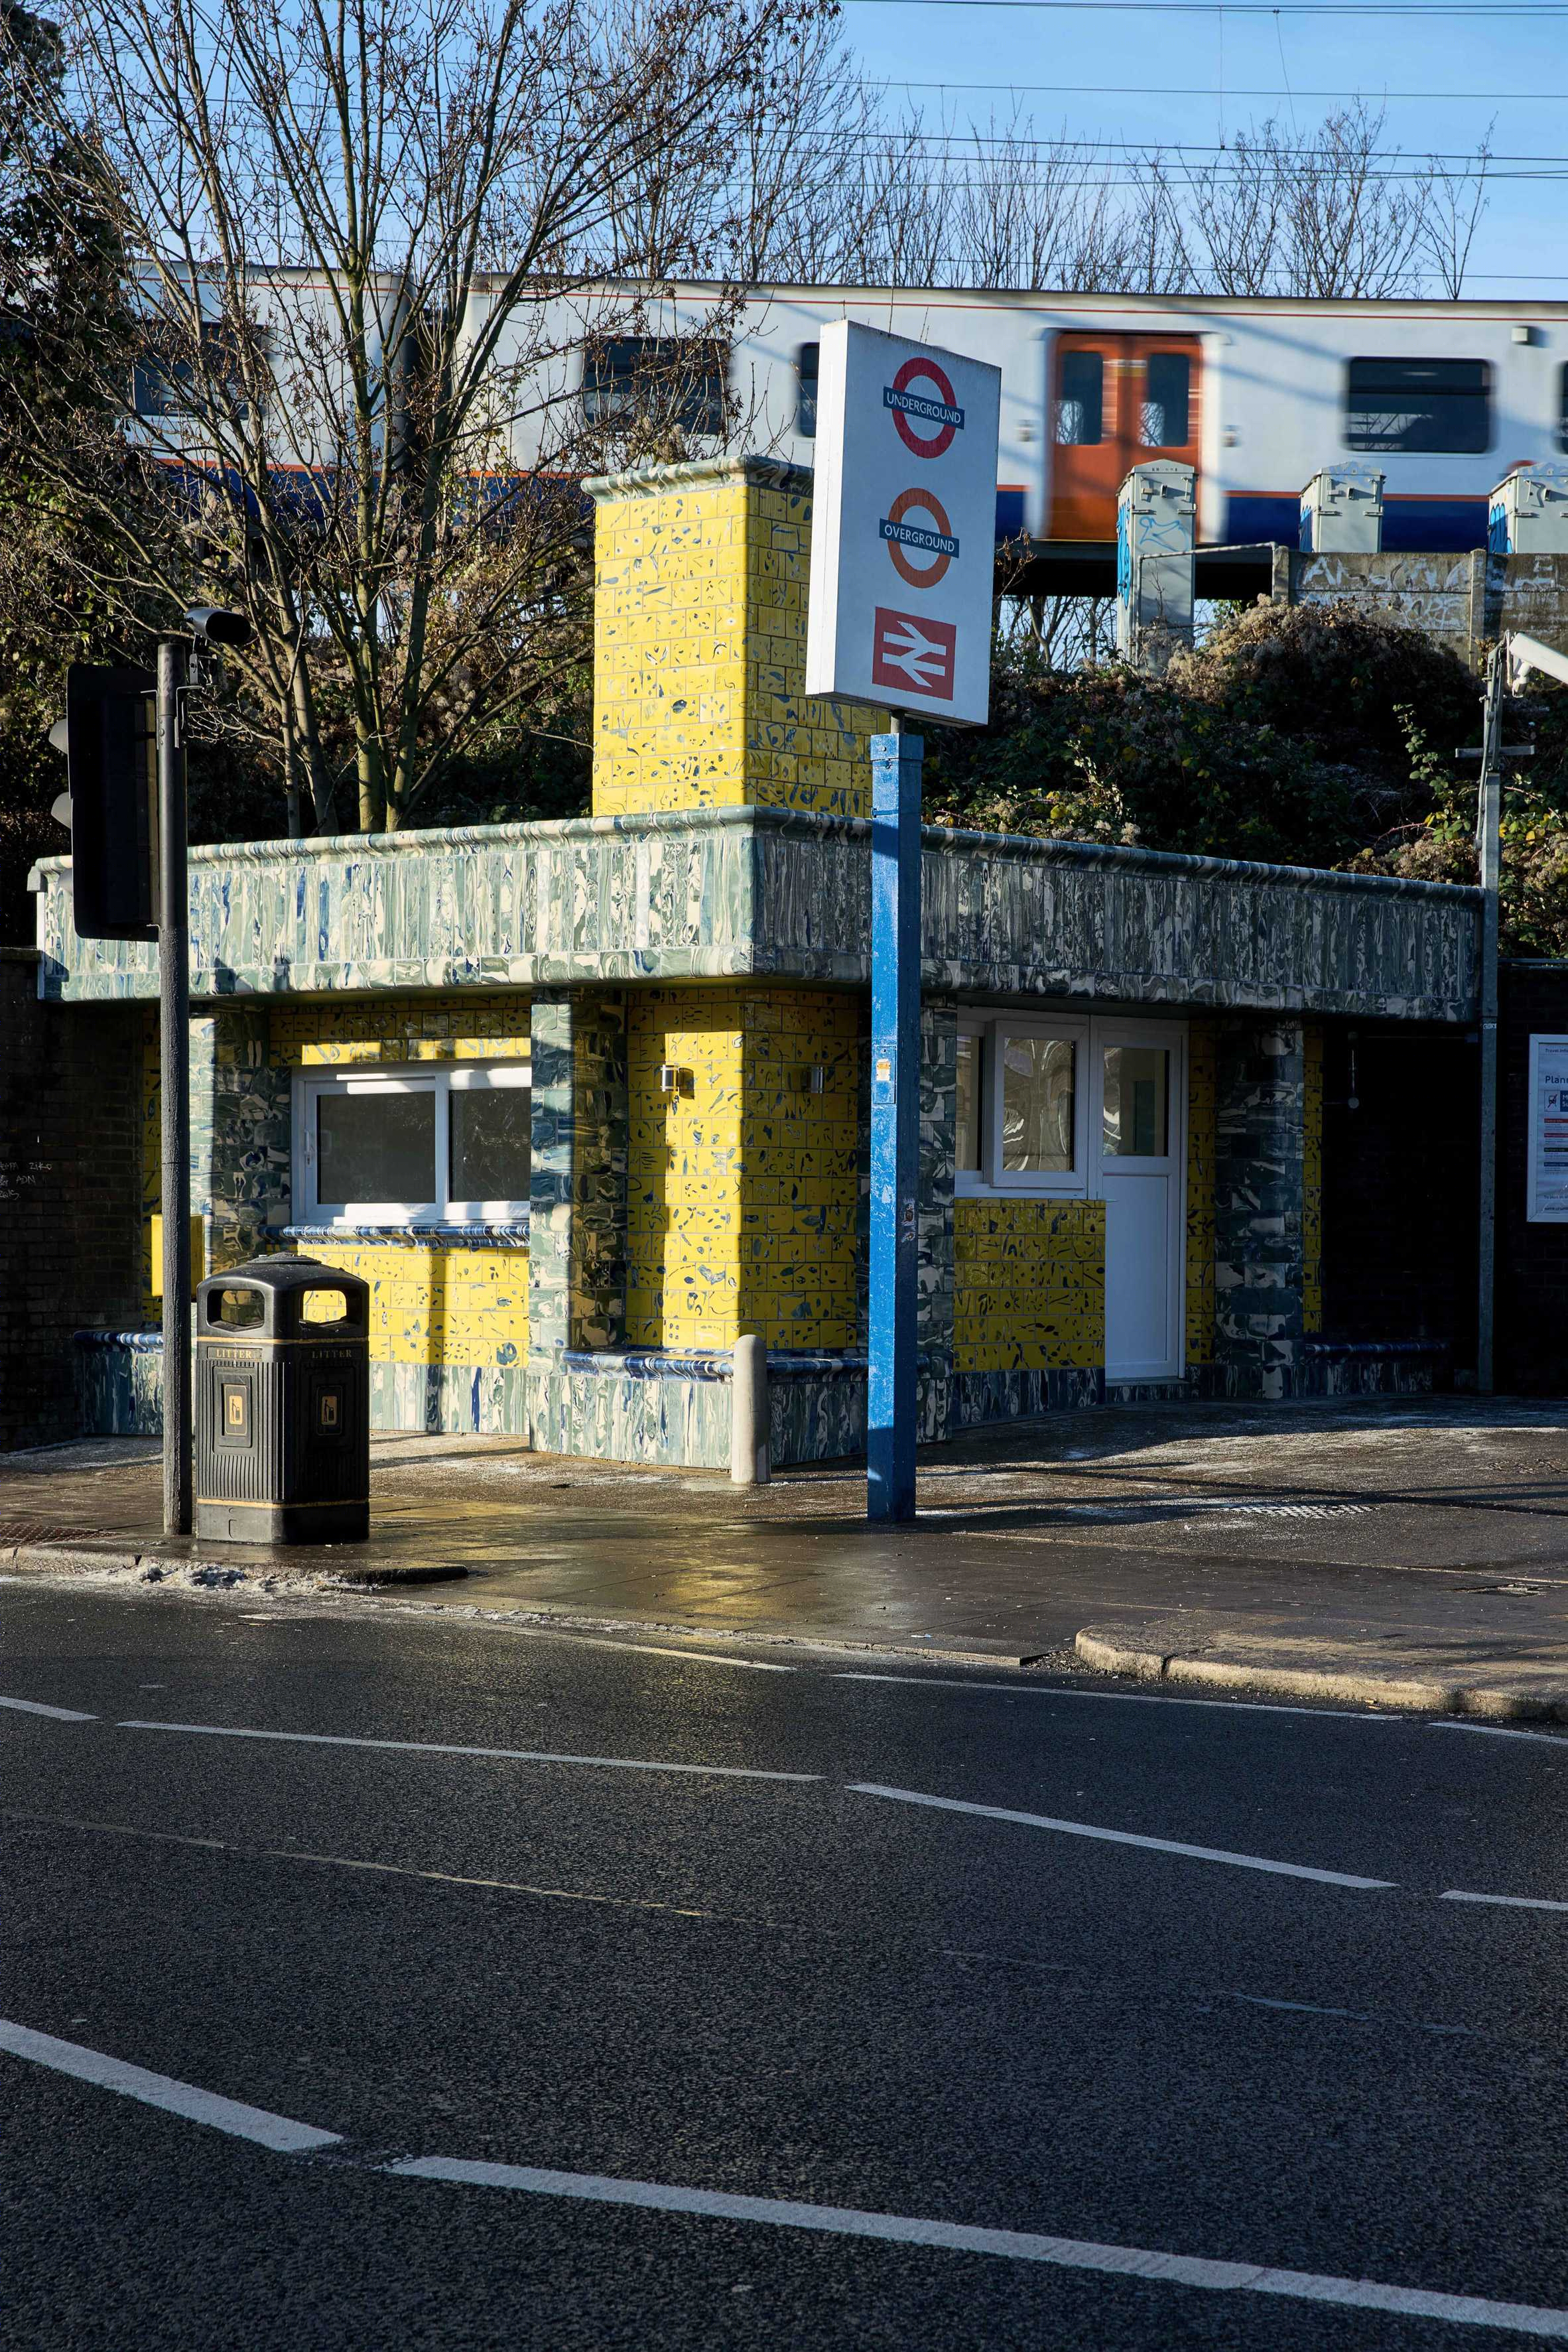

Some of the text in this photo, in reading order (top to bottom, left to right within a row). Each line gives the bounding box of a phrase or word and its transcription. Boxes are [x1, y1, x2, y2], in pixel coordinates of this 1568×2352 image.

[886, 392, 961, 424] UNDERGROUND
[884, 524, 955, 552] OVERGROUND
[216, 1348, 252, 1358] LITTER
[311, 1348, 352, 1359] LITTER
